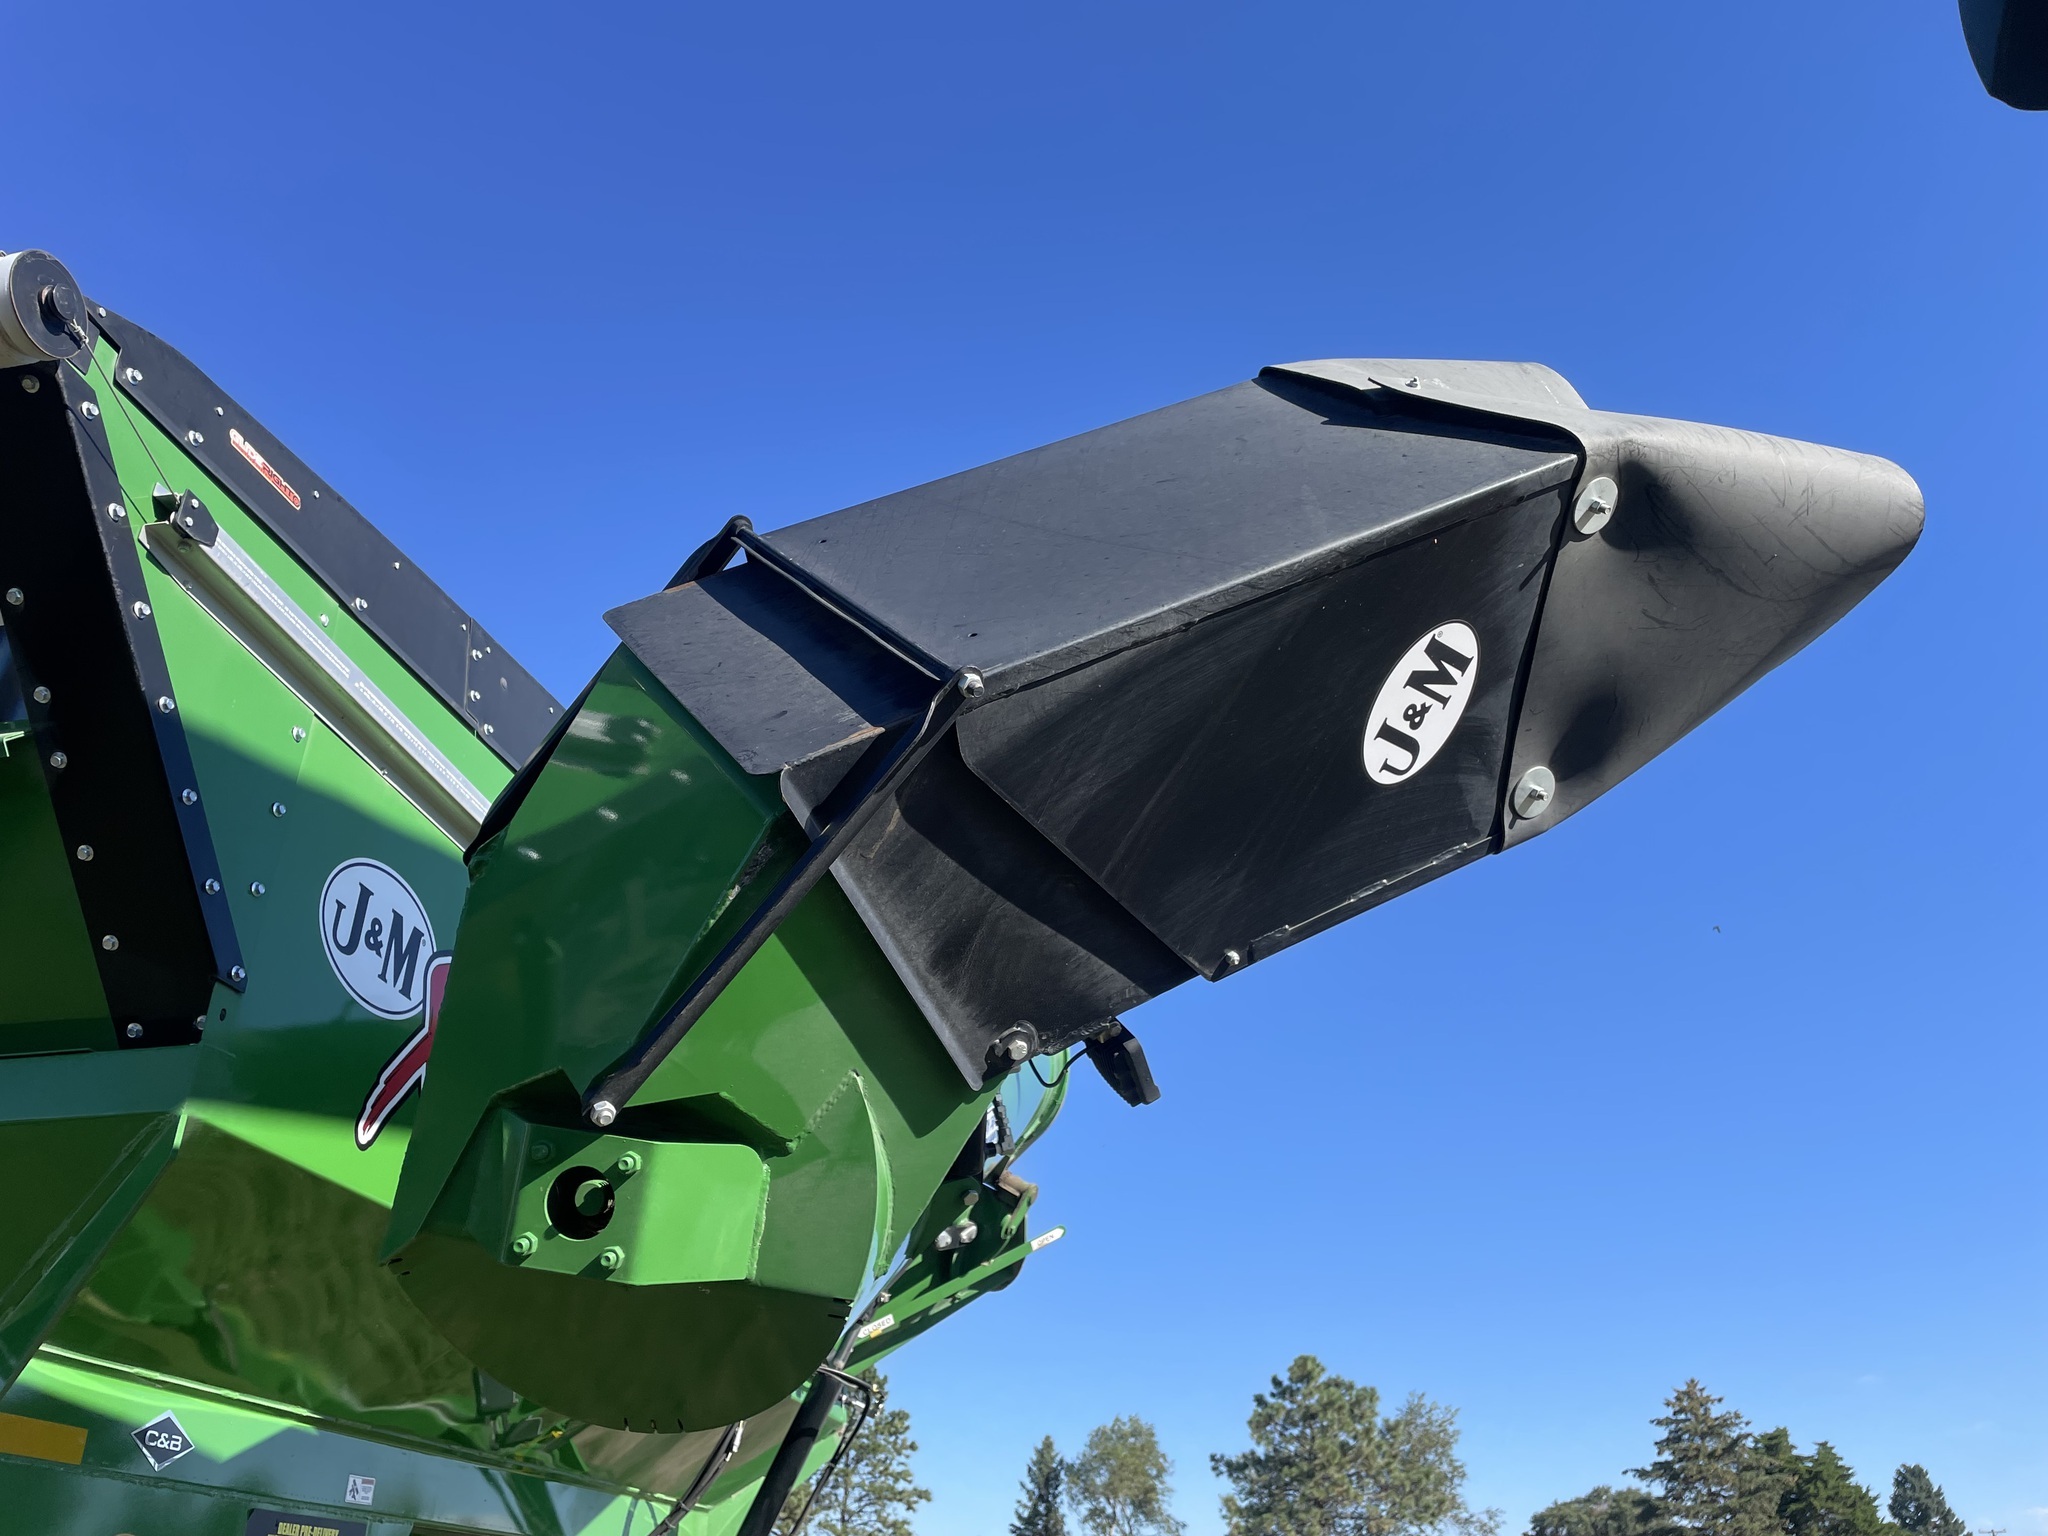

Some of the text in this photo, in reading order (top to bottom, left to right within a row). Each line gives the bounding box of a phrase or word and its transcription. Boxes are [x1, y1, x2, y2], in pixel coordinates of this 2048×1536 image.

[1374, 633, 1474, 776] J&M
[332, 882, 424, 1001] J&M
[1037, 1234, 1054, 1246] OPEN
[863, 1317, 892, 1335] CLOSED
[145, 1430, 182, 1451] C&B
[278, 1522, 301, 1535] DEALER
